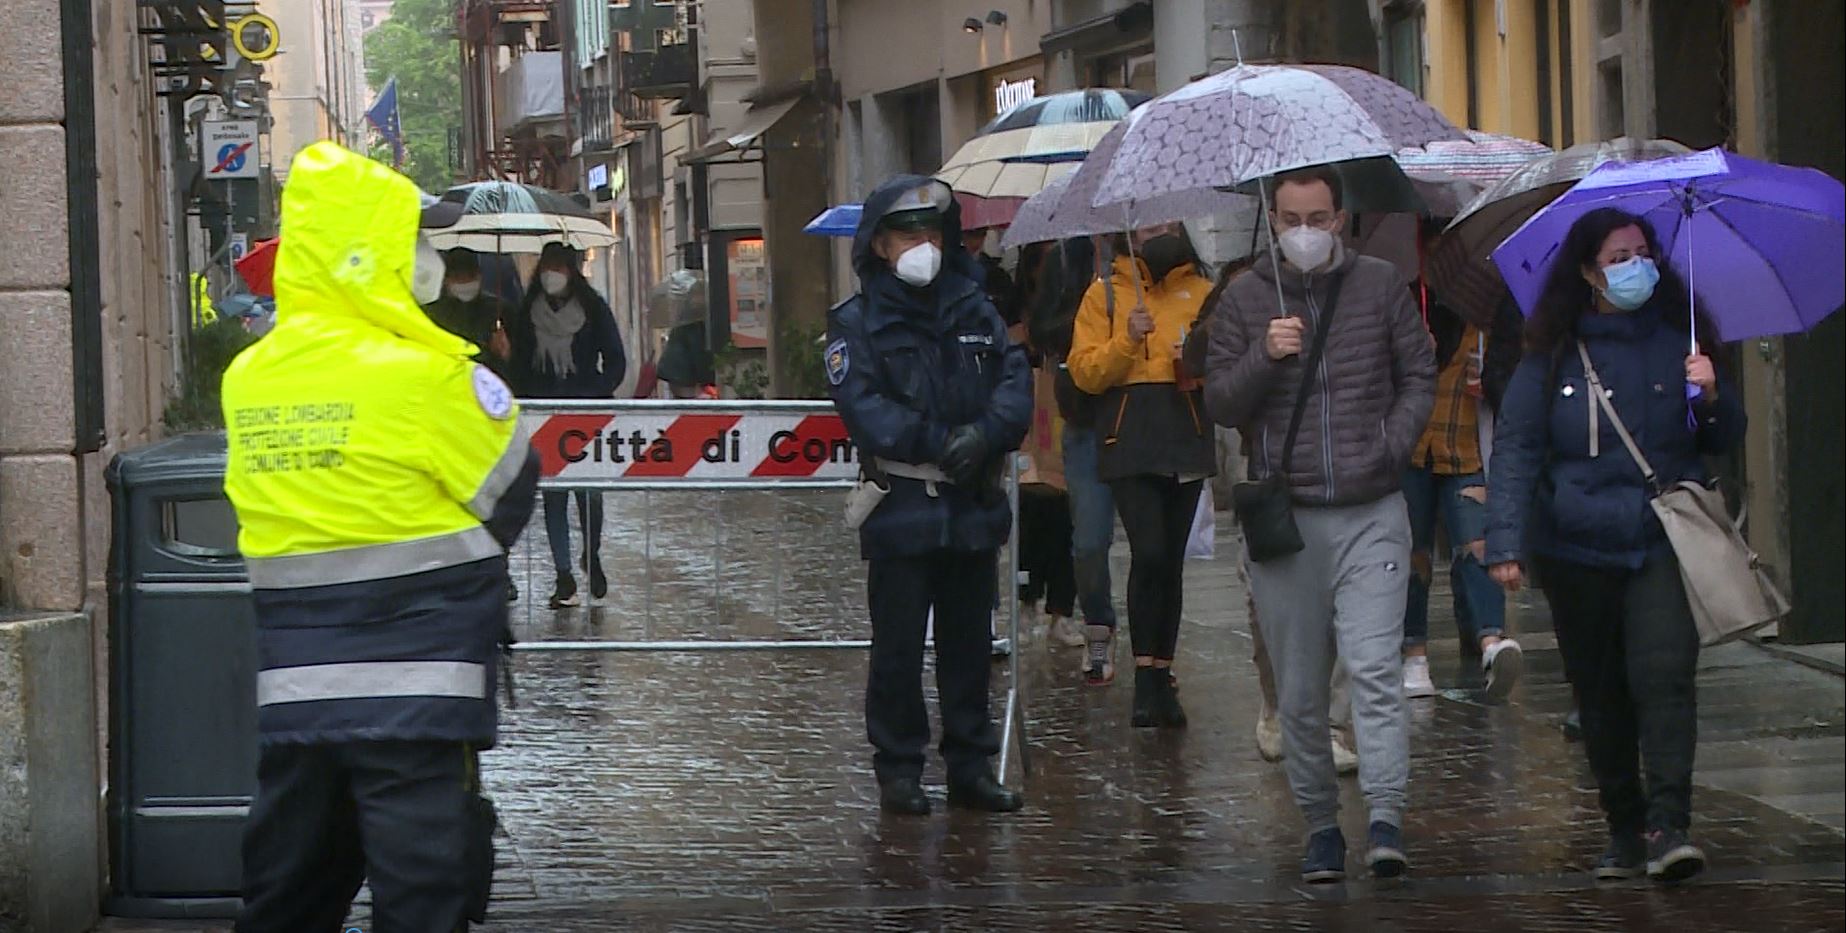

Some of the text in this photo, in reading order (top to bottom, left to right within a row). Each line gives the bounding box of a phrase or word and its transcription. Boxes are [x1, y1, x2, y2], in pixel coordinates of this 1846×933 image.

[558, 429, 860, 463] Città di Com
